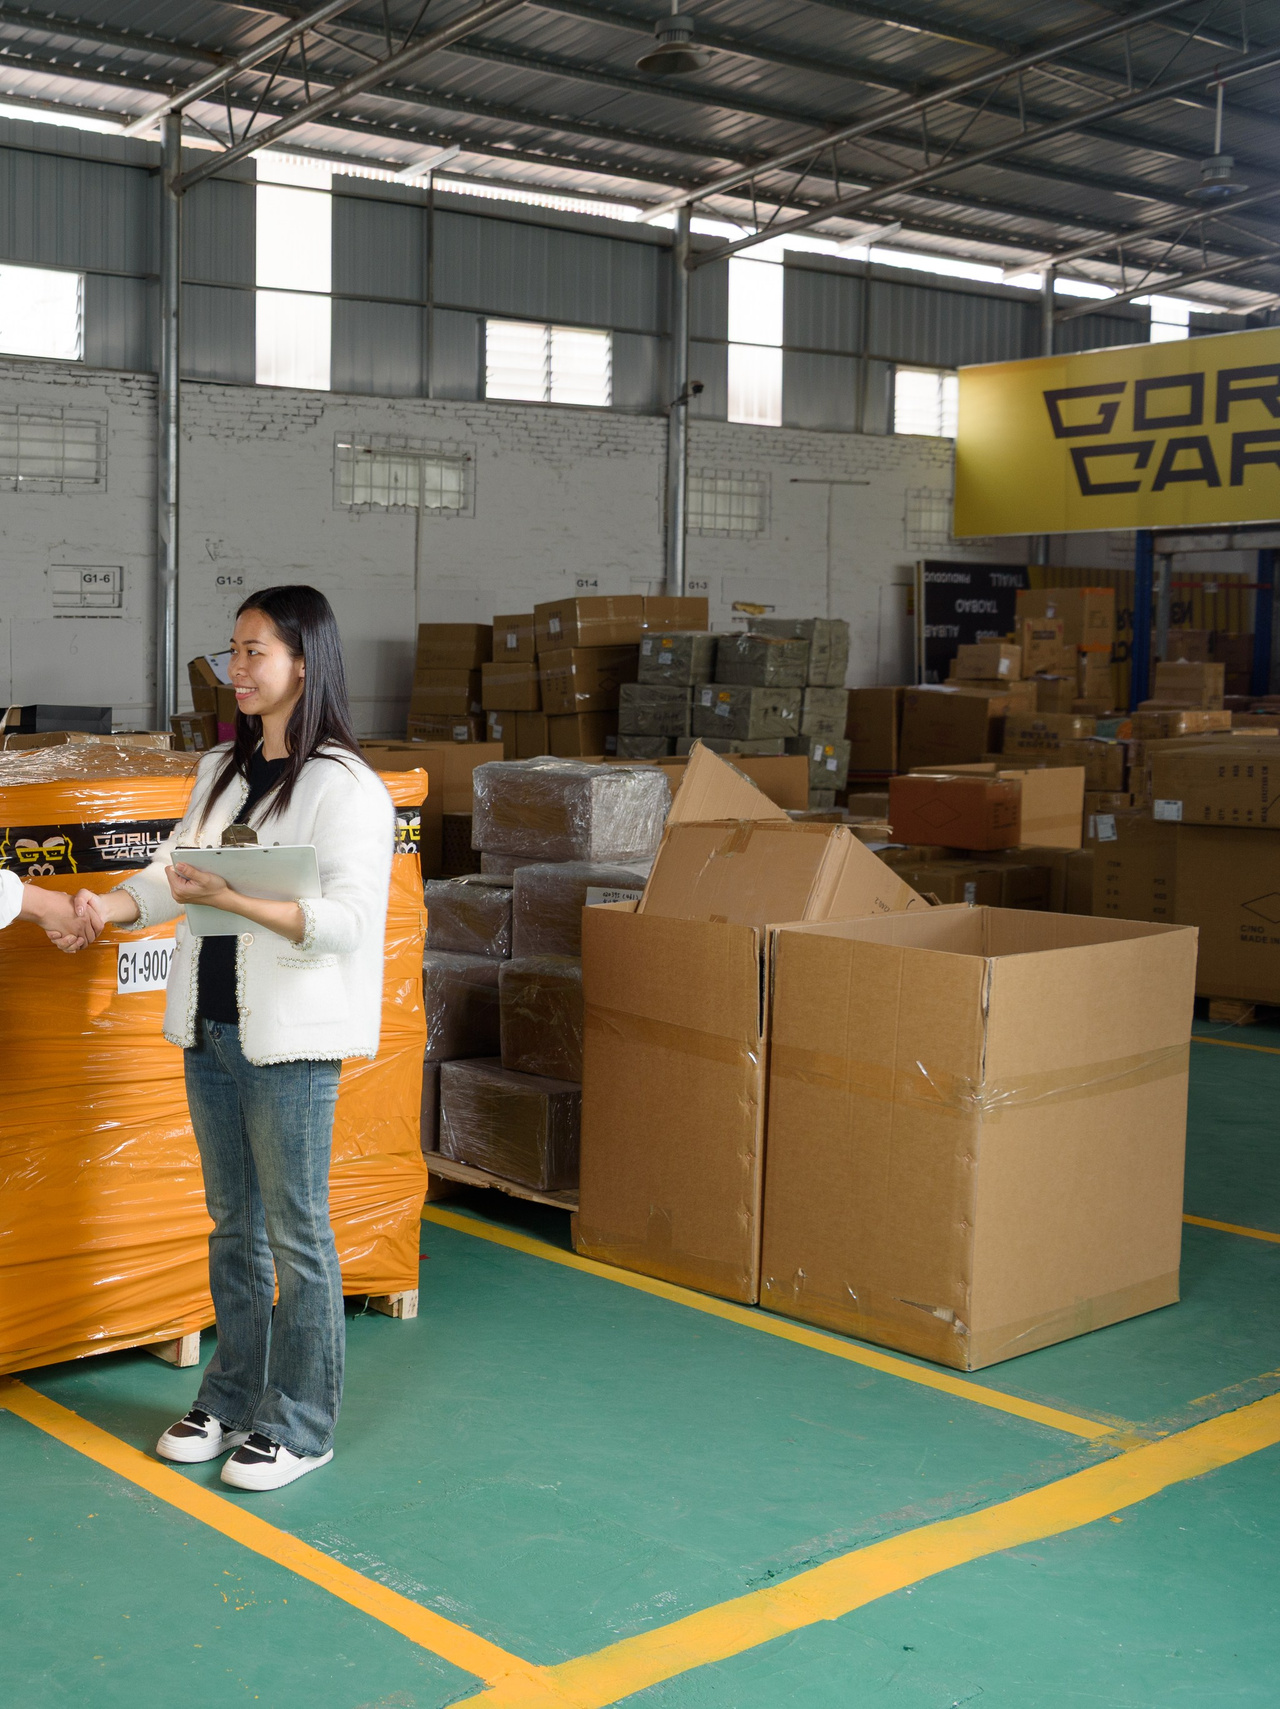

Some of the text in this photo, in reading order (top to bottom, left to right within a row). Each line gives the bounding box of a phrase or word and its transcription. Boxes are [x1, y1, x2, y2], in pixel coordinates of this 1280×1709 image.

[83, 573, 110, 583] G1-6
[216, 576, 243, 585] G1-5
[576, 579, 598, 587] G1-4
[688, 581, 708, 590] G1-3
[955, 599, 998, 613] TAOBAO
[93, 831, 175, 848] GORILL
[1240, 934, 1269, 944] MADE
